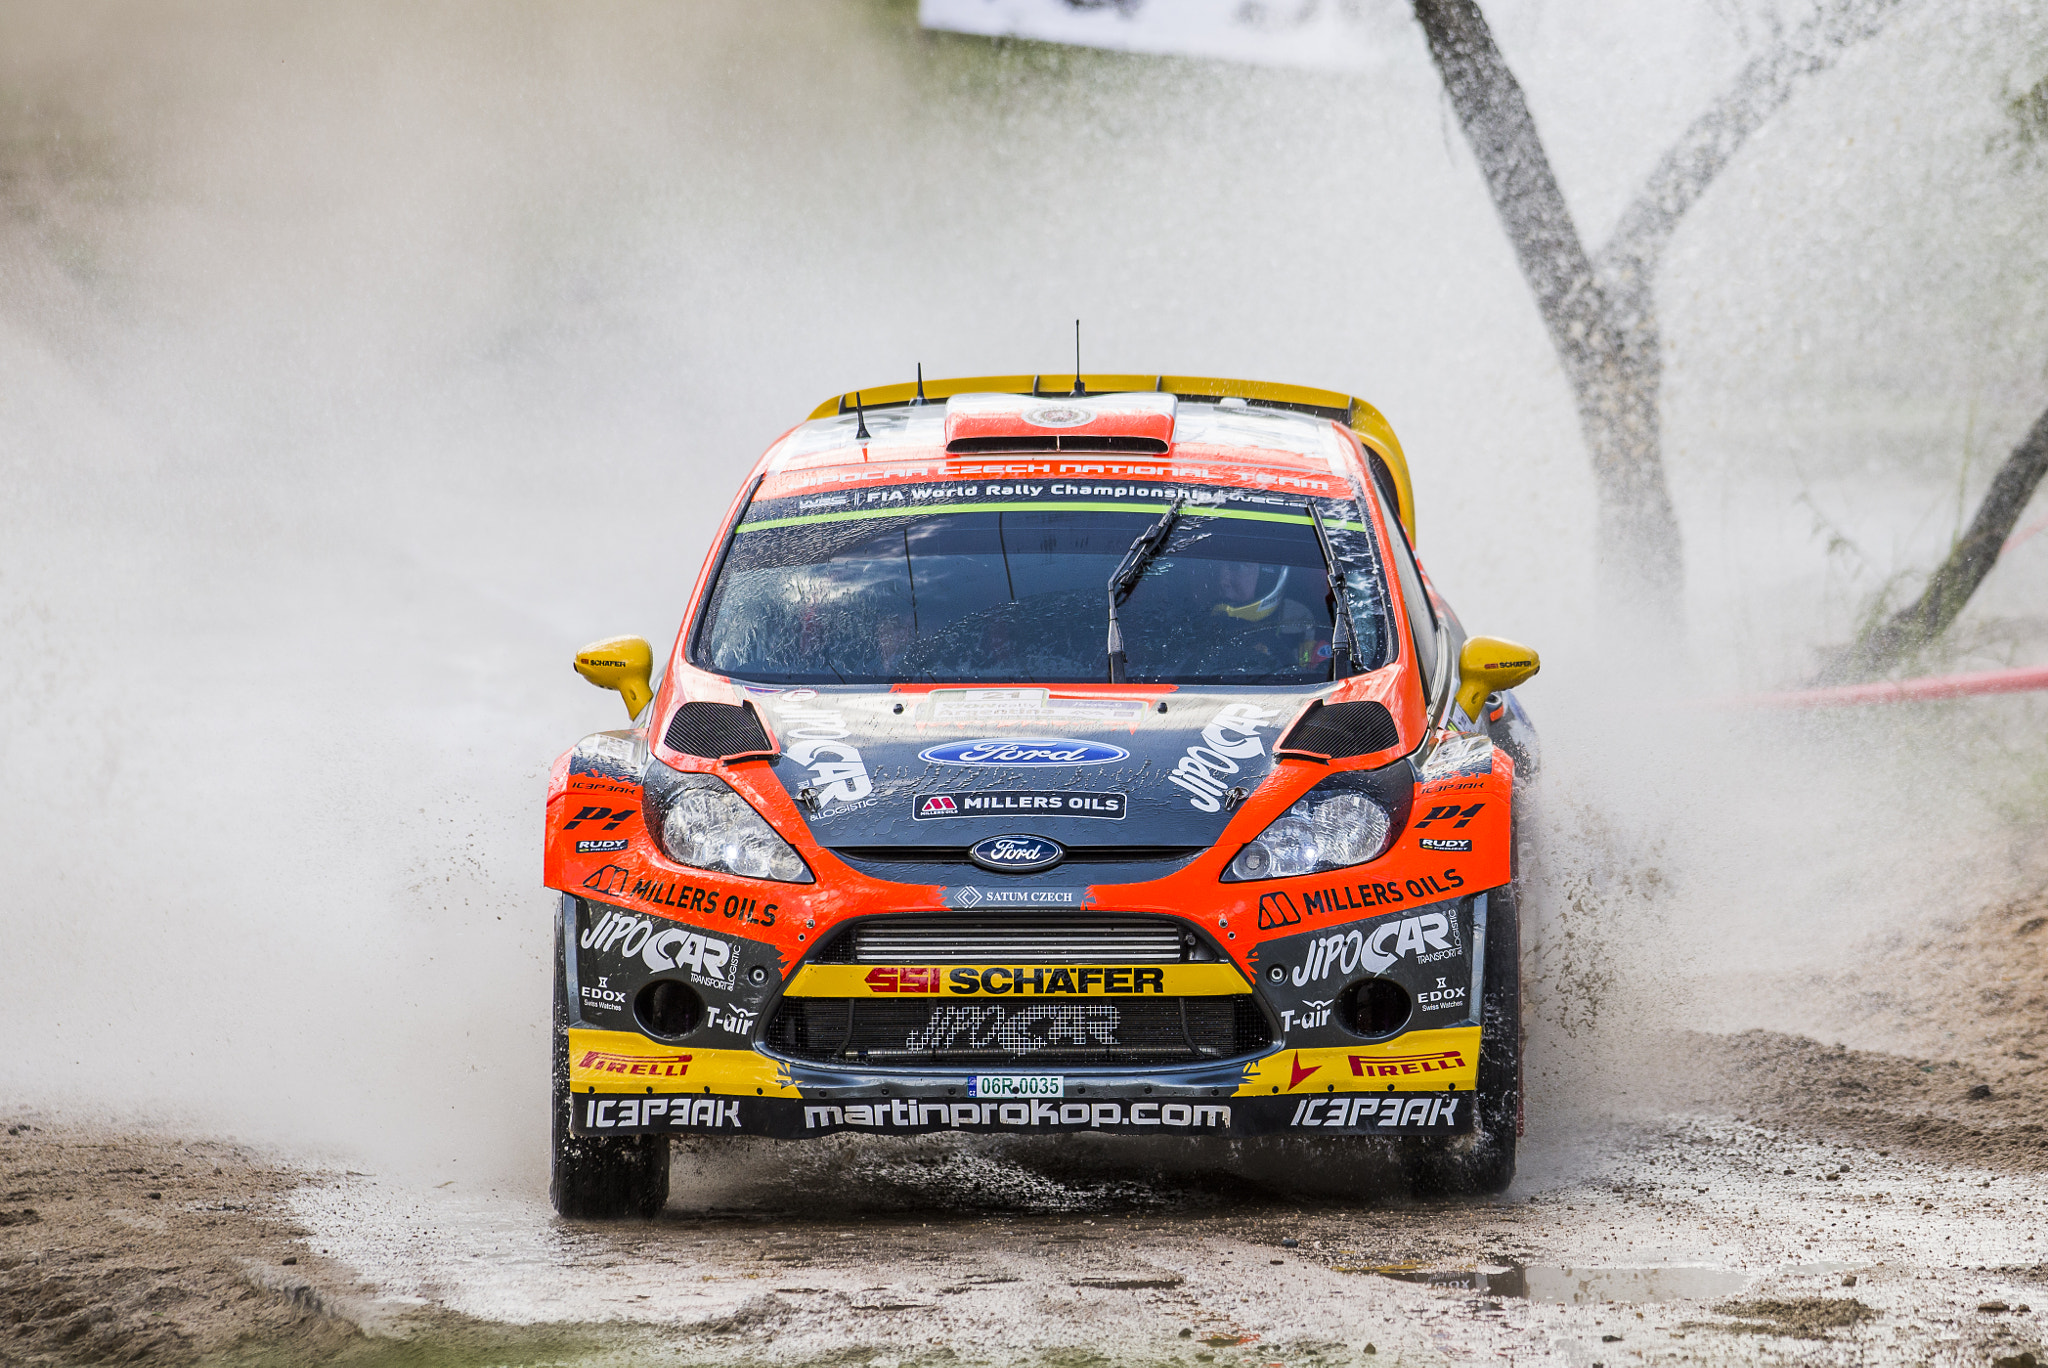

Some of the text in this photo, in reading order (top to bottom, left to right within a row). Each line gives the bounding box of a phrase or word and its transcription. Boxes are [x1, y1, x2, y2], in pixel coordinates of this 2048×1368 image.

[938, 464, 1051, 475] CZECH
[1059, 464, 1223, 479] NATIONAL
[1235, 472, 1329, 491] TEAM
[867, 484, 1213, 503] FIA World Rally Championship
[981, 691, 1021, 700] 21
[958, 741, 1089, 762] Ford
[963, 797, 1119, 811] MILLERS OILS
[563, 806, 637, 830] P1
[1414, 803, 1486, 828] P1
[579, 840, 625, 848] RUDY
[989, 839, 1041, 861] Ford
[1422, 839, 1469, 847] RUDY
[986, 891, 1073, 902] SATUM CZECH
[1303, 868, 1465, 915] MILLERS OILS
[629, 878, 779, 927] MILLERS OILS
[1416, 948, 1457, 965] TRANSPORT
[691, 973, 729, 990] TRANSPORT
[864, 967, 940, 993] SSI
[581, 986, 626, 1003] EDOX
[1417, 986, 1466, 1003] EDOX
[598, 1001, 622, 1012] Watches
[1422, 1000, 1464, 1012] Swiss Watches
[707, 1006, 754, 1035] T-air
[1281, 1005, 1331, 1032] T-air
[579, 1051, 692, 1076] PIRELLI
[1348, 1051, 1466, 1076] PIRELLI
[803, 1099, 1232, 1128] martinprokop.com
